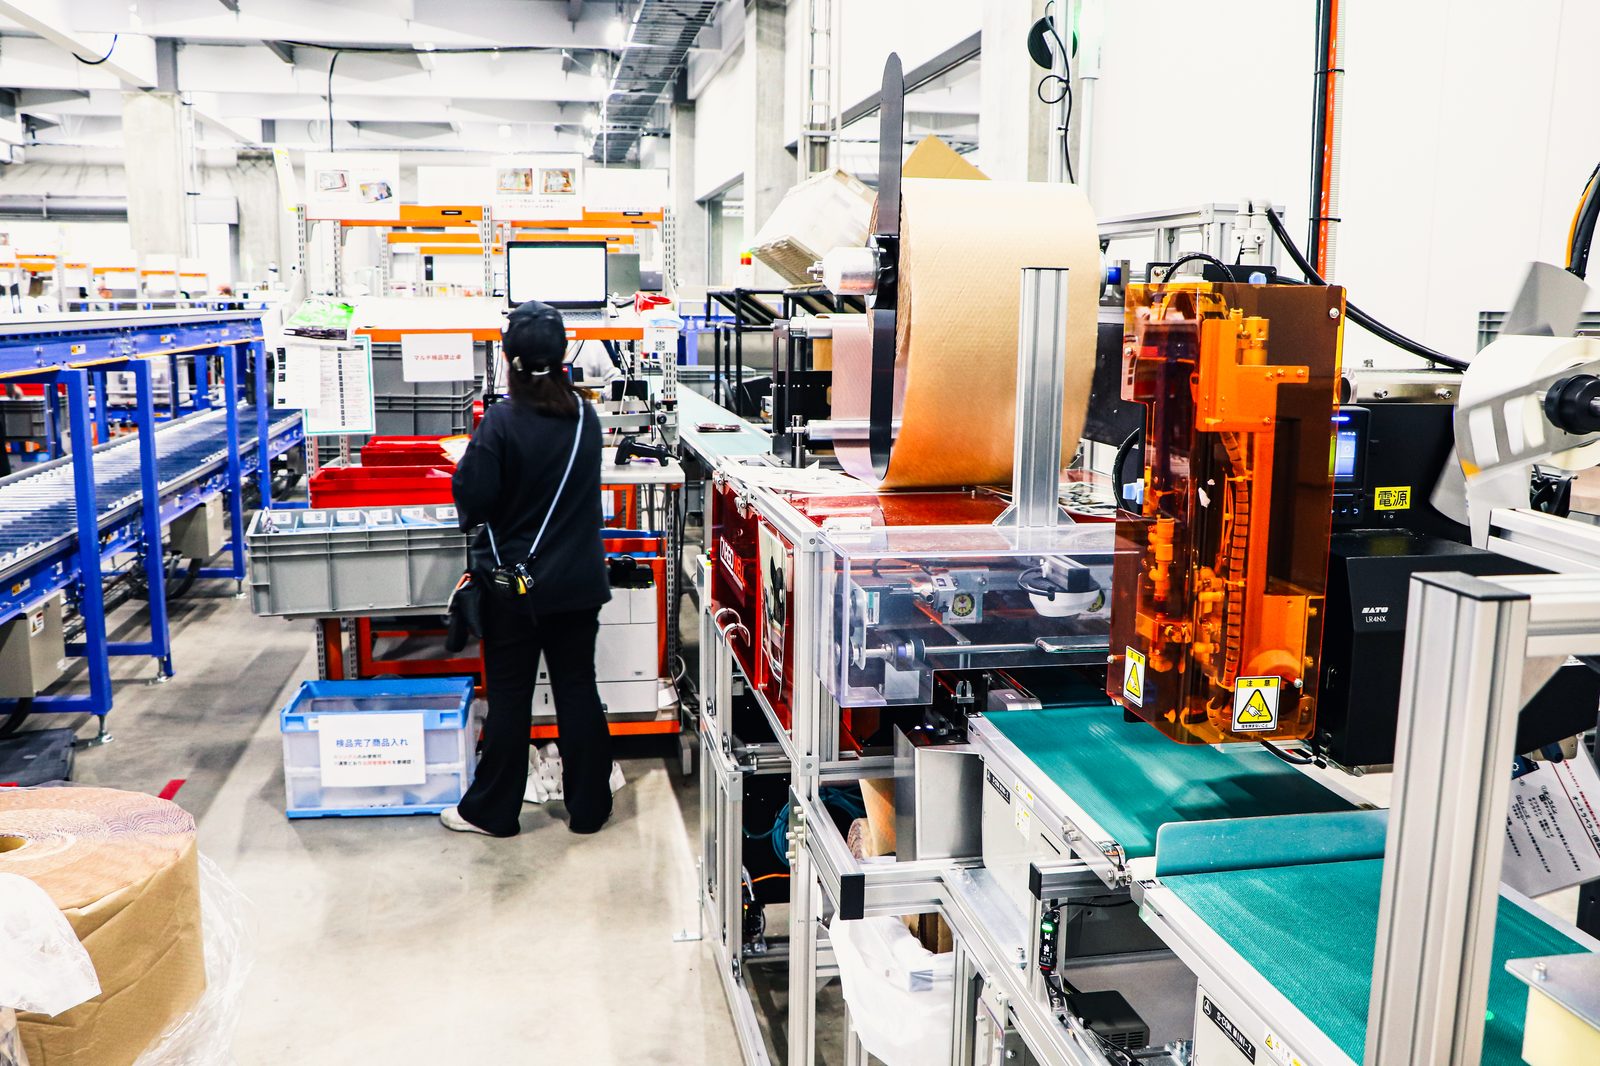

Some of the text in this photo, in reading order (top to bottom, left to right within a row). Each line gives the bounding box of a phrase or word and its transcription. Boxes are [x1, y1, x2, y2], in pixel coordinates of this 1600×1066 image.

[1377, 490, 1408, 507] 電源
[1361, 606, 1389, 614] SATO
[1365, 615, 1387, 623] LR4NX
[336, 738, 409, 748] 検品完了商品入れ
